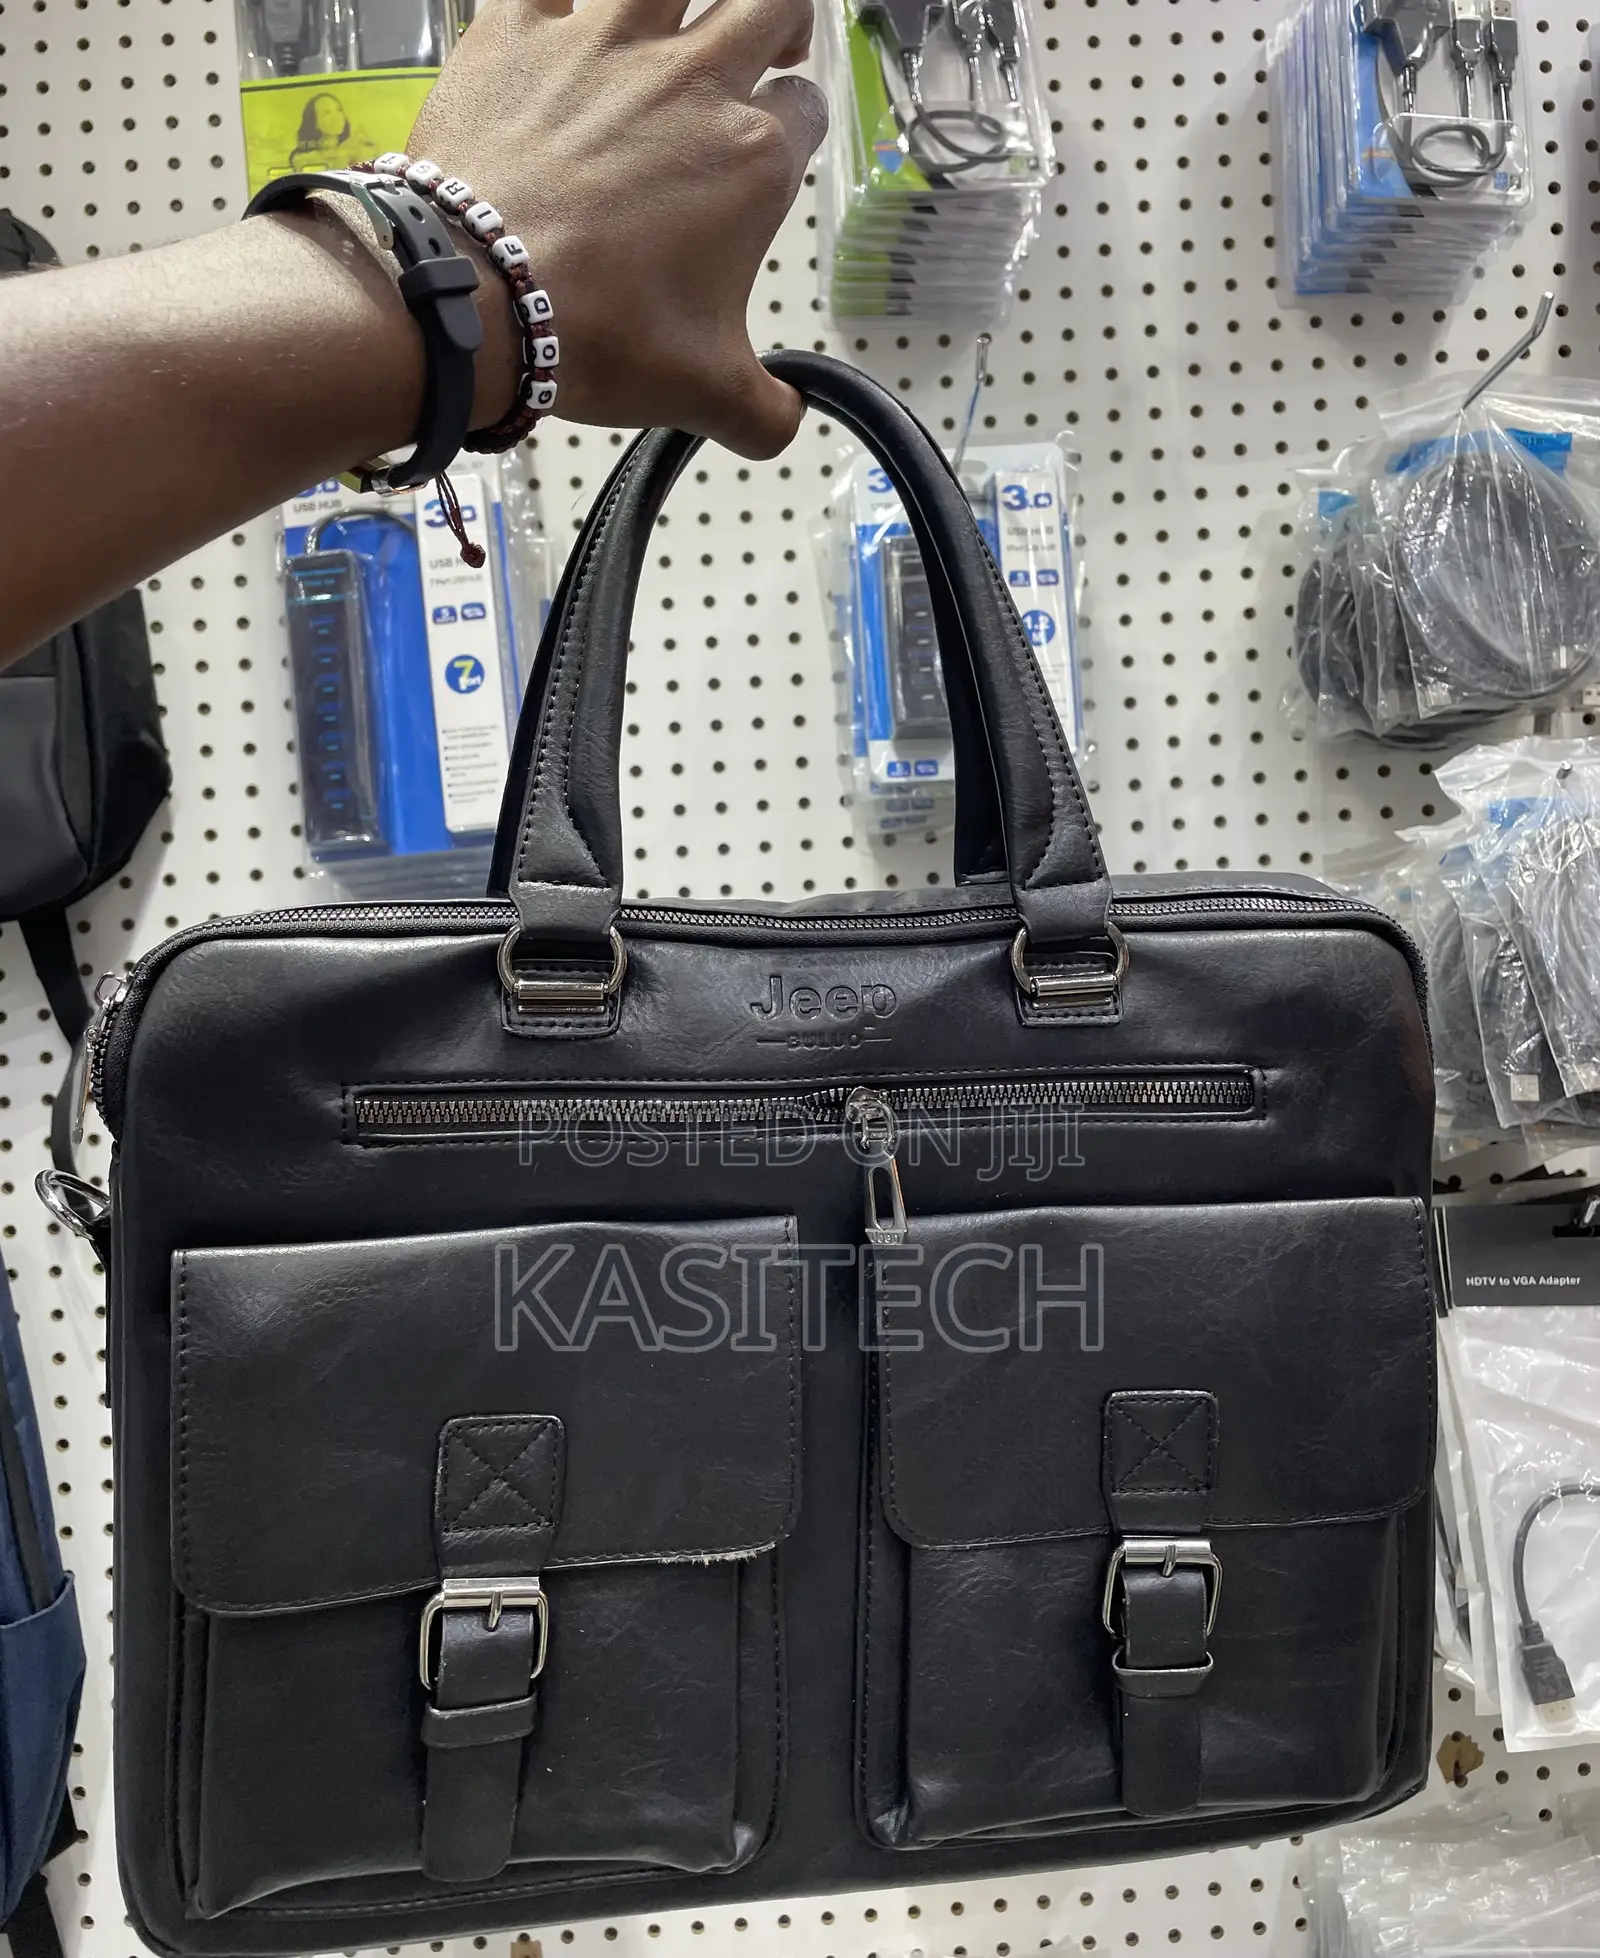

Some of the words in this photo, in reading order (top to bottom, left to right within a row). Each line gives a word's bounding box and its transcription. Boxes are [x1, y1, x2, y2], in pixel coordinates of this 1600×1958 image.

[750, 974, 898, 1031] Jeep
[1466, 1276, 1496, 1287] HDTV
[1499, 1276, 1510, 1286] to
[1512, 1276, 1536, 1286] VGA
[1538, 1275, 1581, 1287] Adapter
